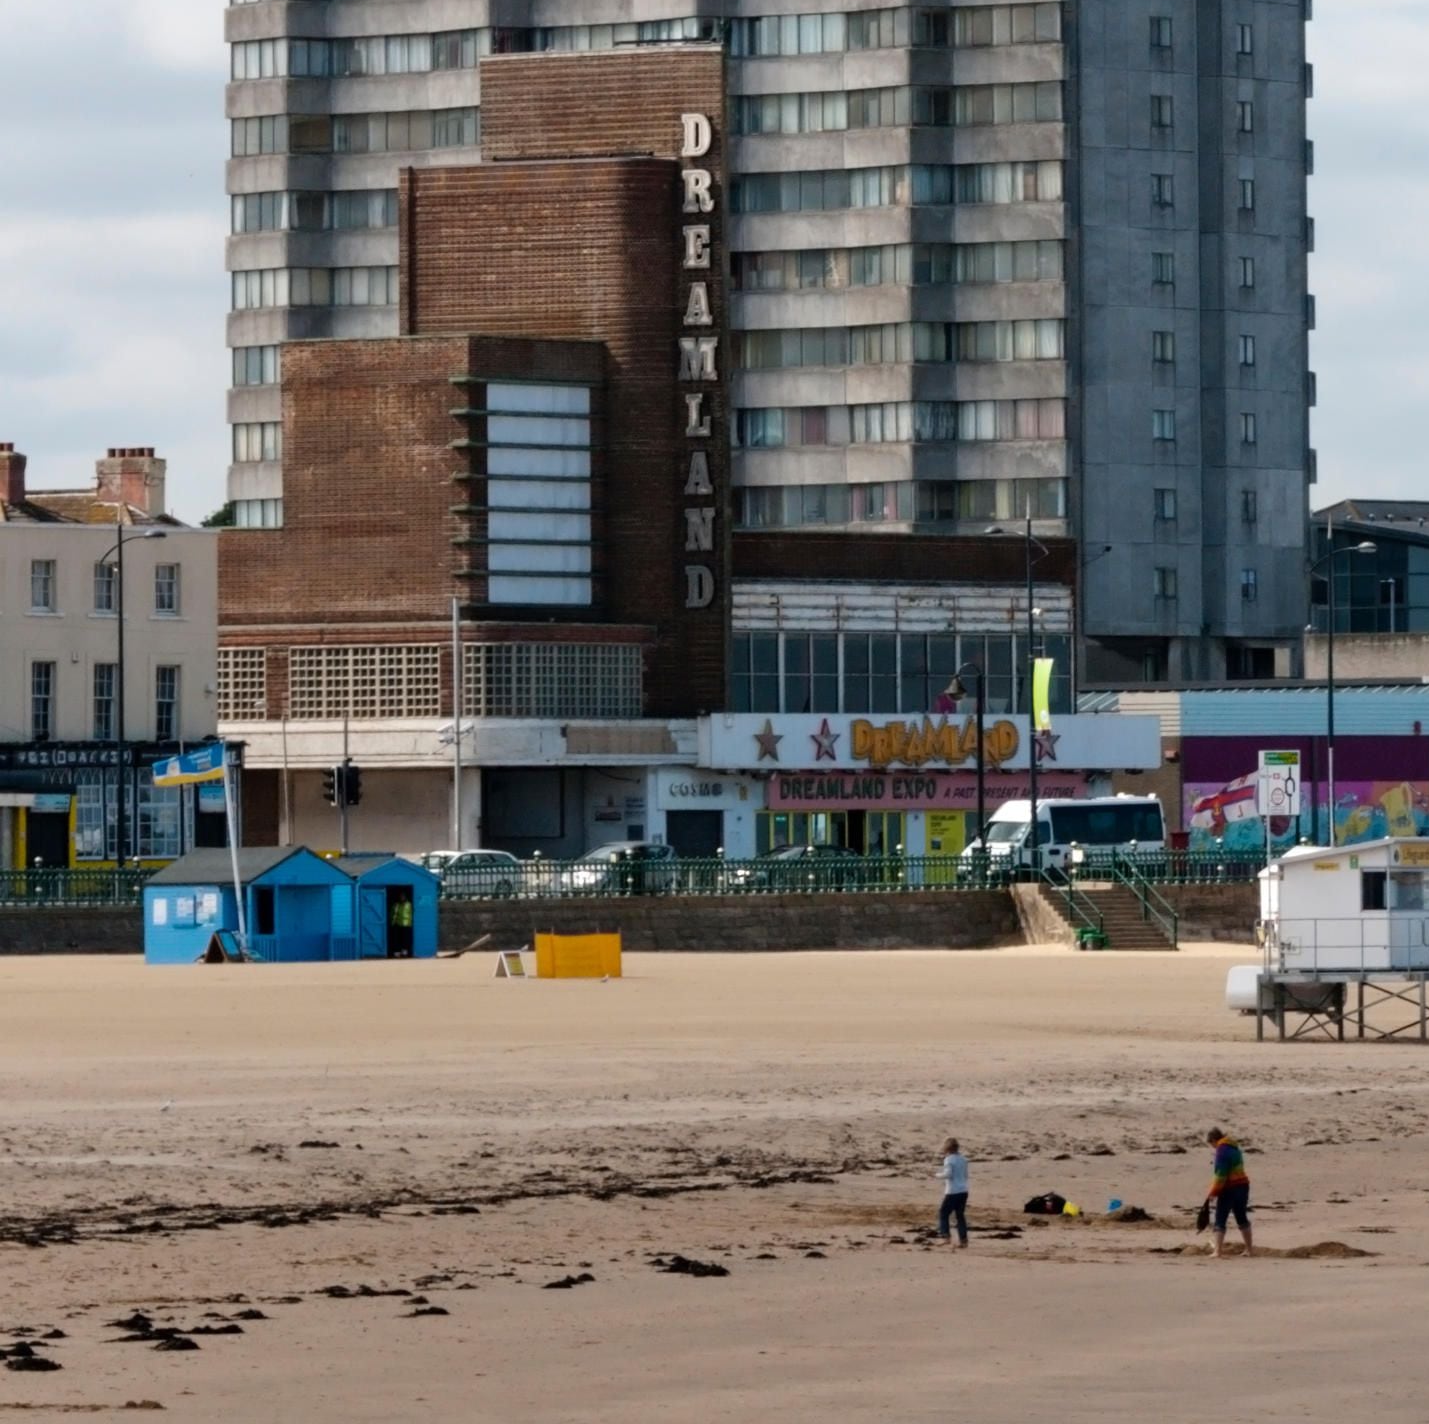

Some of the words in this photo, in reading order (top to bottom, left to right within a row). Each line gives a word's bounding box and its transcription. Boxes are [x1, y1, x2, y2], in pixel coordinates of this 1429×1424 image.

[679, 113, 718, 609] DREAMLAND
[851, 713, 1021, 768] DREAMLAND
[779, 778, 885, 800] DREAMLAND
[892, 778, 937, 799] EXPO
[943, 787, 951, 798] A
[1042, 786, 1076, 798] FUTURE
